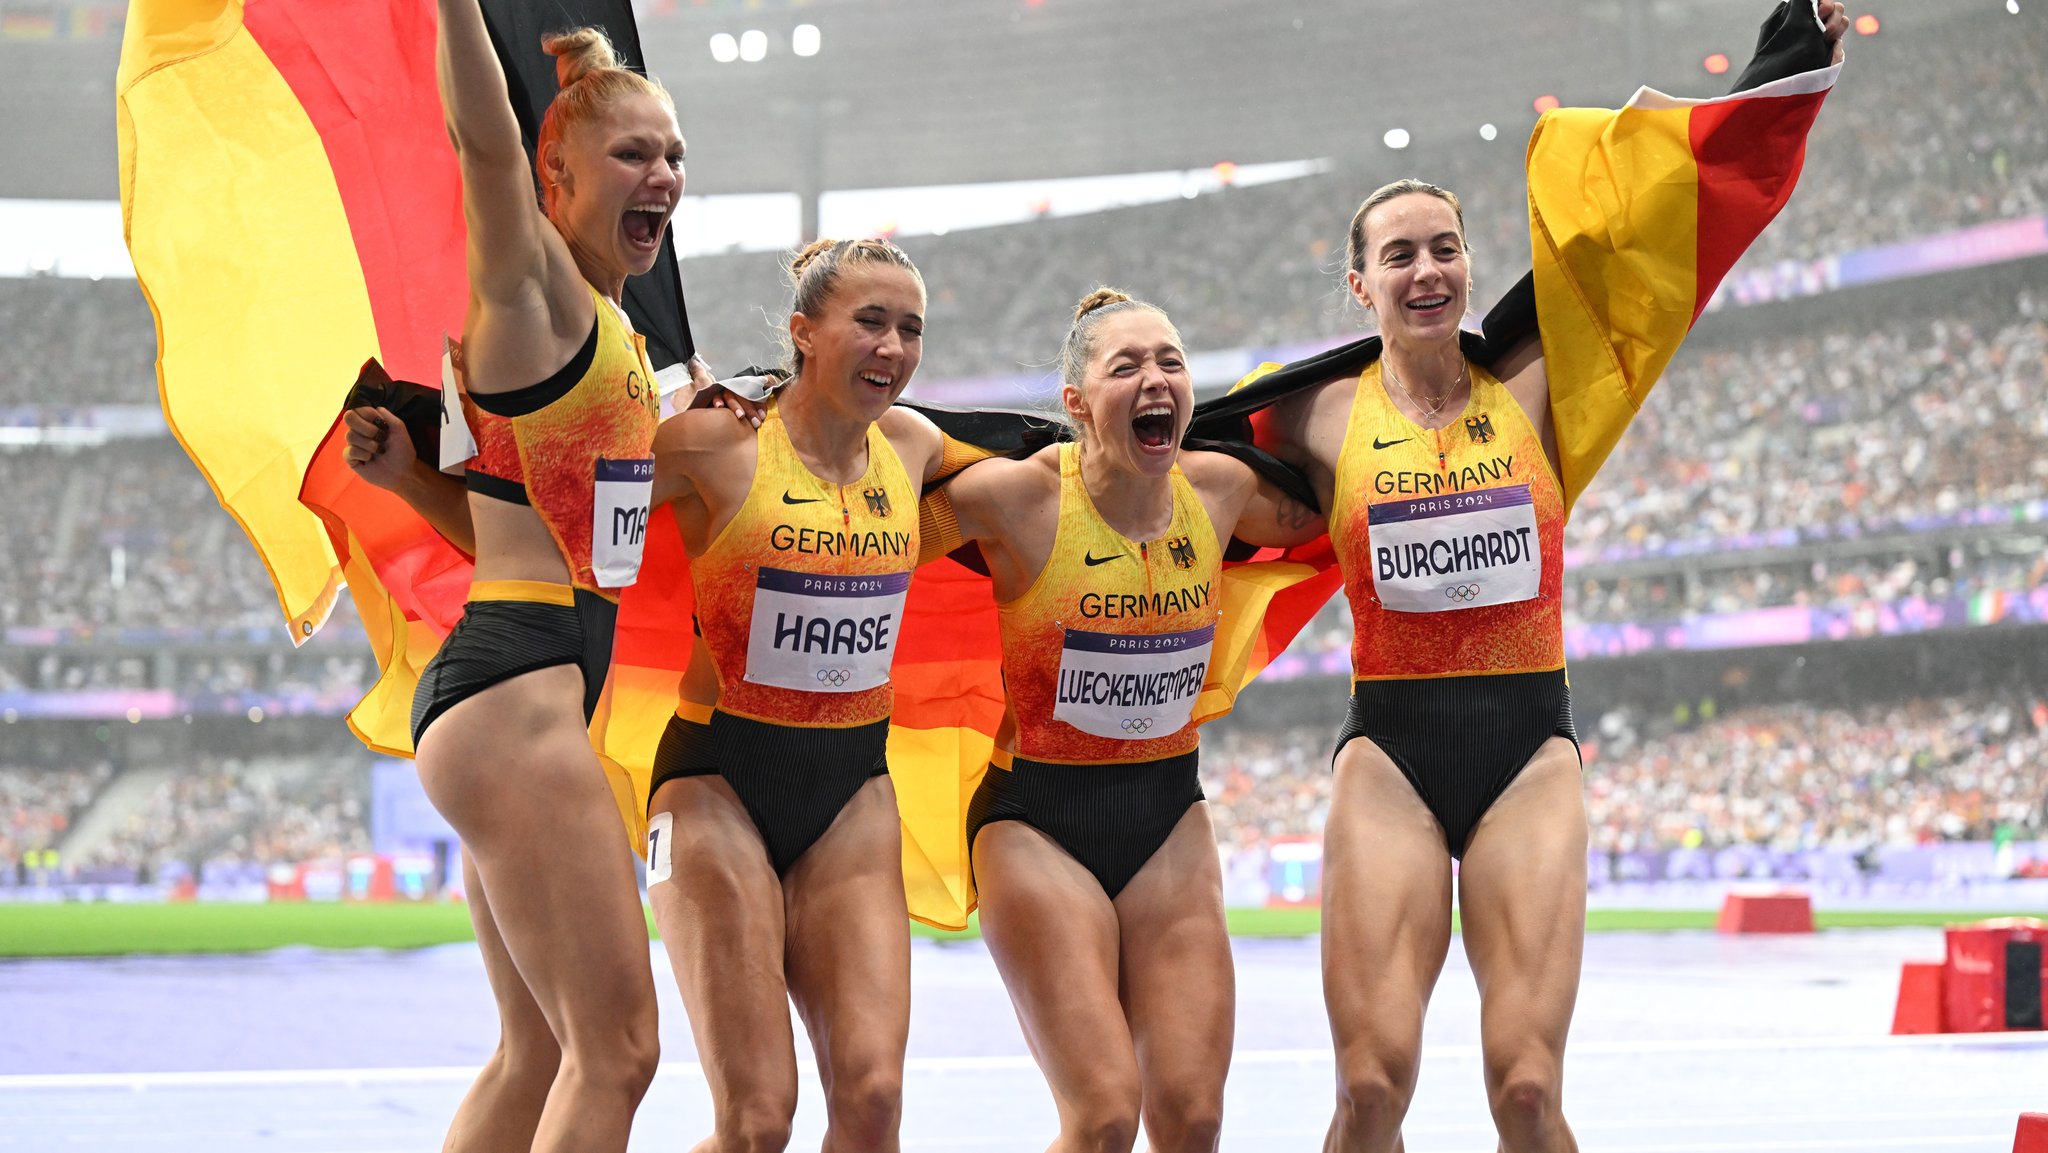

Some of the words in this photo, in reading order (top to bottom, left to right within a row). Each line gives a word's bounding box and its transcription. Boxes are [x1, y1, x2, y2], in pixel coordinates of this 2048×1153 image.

[633, 463, 655, 475] PAR
[1375, 455, 1513, 495] GERMANY
[1411, 500, 1451, 514] PARIS
[1456, 494, 1492, 508] 2024
[612, 506, 649, 546] MA
[770, 524, 910, 557] GERMANY
[1377, 526, 1531, 581] BURGHARDT
[804, 578, 846, 592] PARIS
[850, 581, 883, 592] 2024
[1079, 581, 1210, 619] GERMANY
[773, 612, 891, 655] HAASE
[1109, 638, 1150, 649] PARIS
[1154, 637, 1187, 649] 2024
[1058, 662, 1206, 707] LUECKENKEMPER
